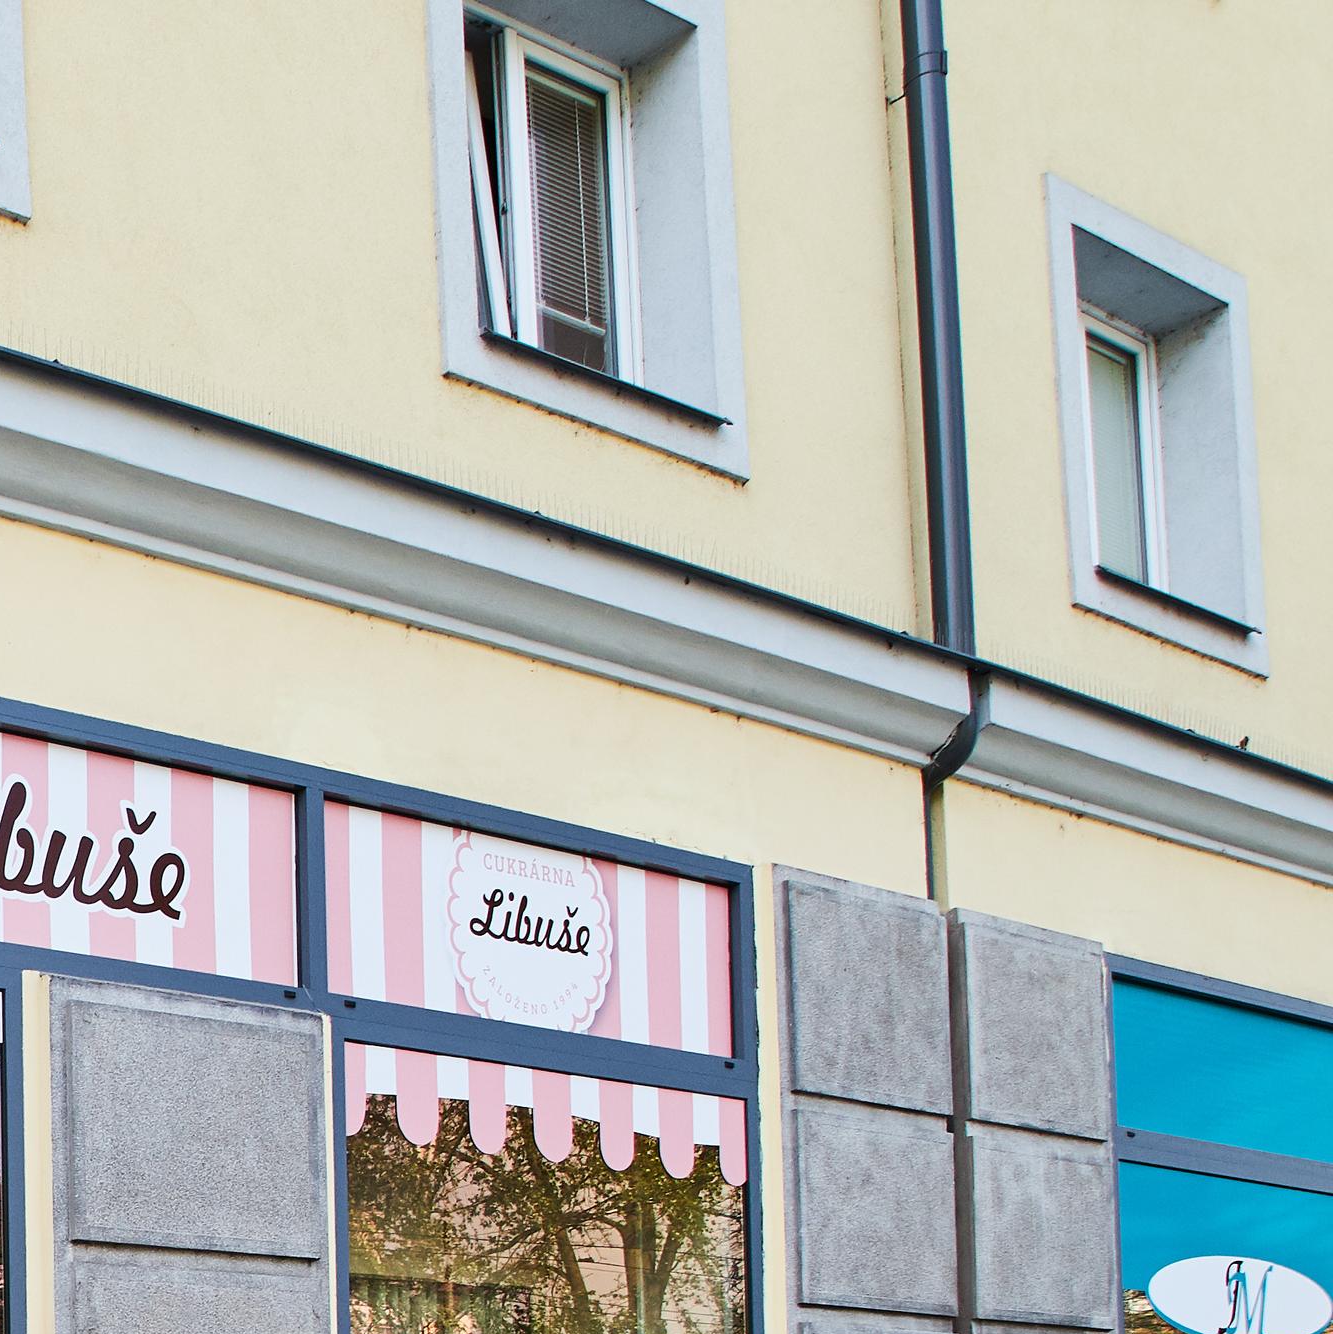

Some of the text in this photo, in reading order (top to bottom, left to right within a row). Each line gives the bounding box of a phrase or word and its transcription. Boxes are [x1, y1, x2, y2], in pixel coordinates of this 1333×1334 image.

[483, 852, 575, 888] CUKRÁRNA
[469, 888, 591, 957] Libuše
[482, 965, 549, 1016] ZALOŽENO
